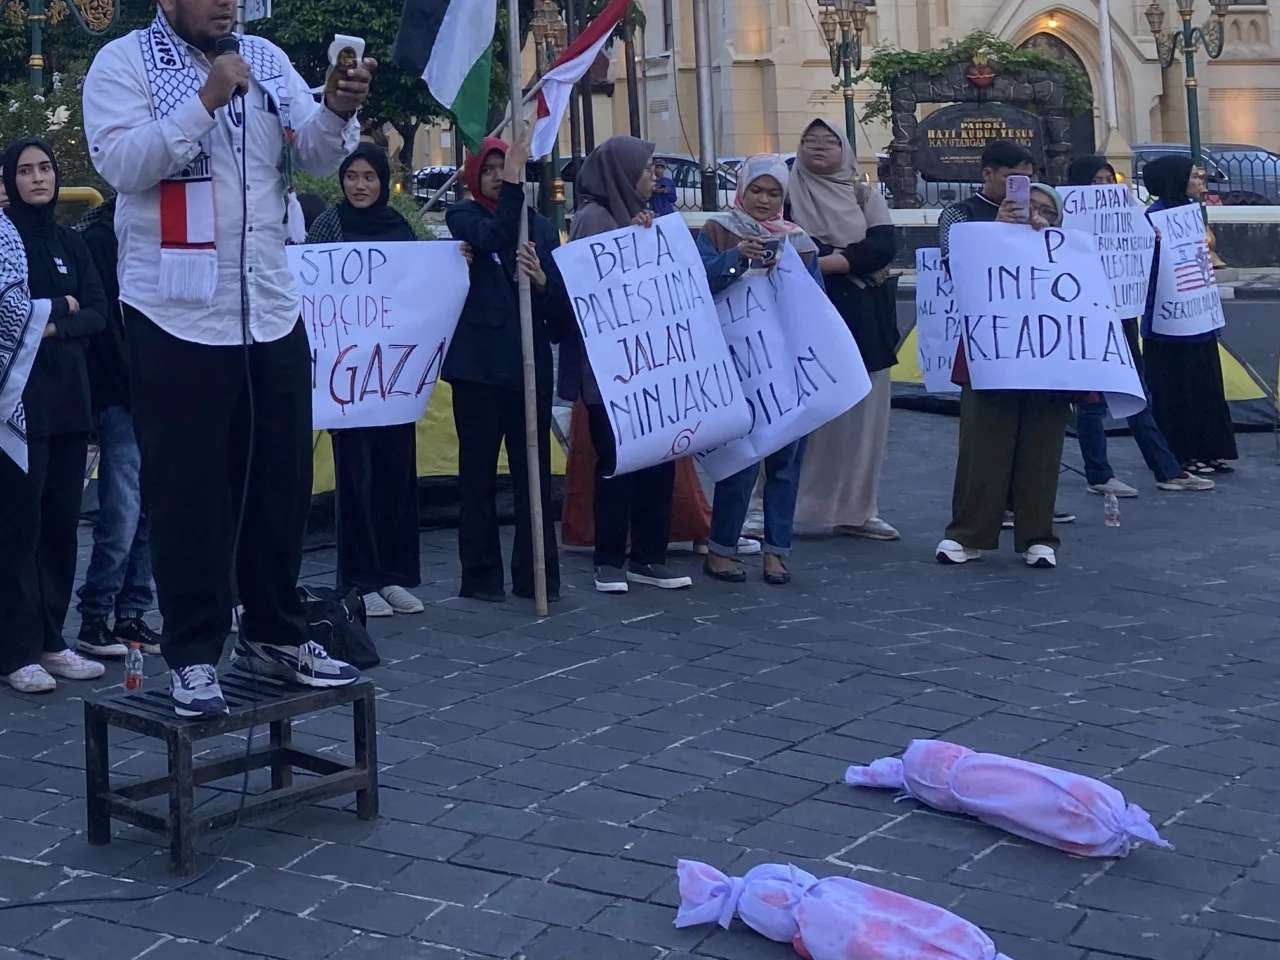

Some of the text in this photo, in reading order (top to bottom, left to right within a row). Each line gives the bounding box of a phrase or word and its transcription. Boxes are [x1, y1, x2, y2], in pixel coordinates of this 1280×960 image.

[961, 129, 997, 138] KUDUS
[1001, 129, 1034, 138] YESUS
[300, 247, 387, 286] STOP
[590, 224, 676, 282] BELA
[1044, 229, 1066, 264] P
[301, 294, 395, 334] NOCIDE
[573, 267, 705, 339] PALESTINA
[329, 337, 447, 406] GAZA
[613, 318, 697, 384] JALAN
[609, 359, 735, 447] NINJAKU
